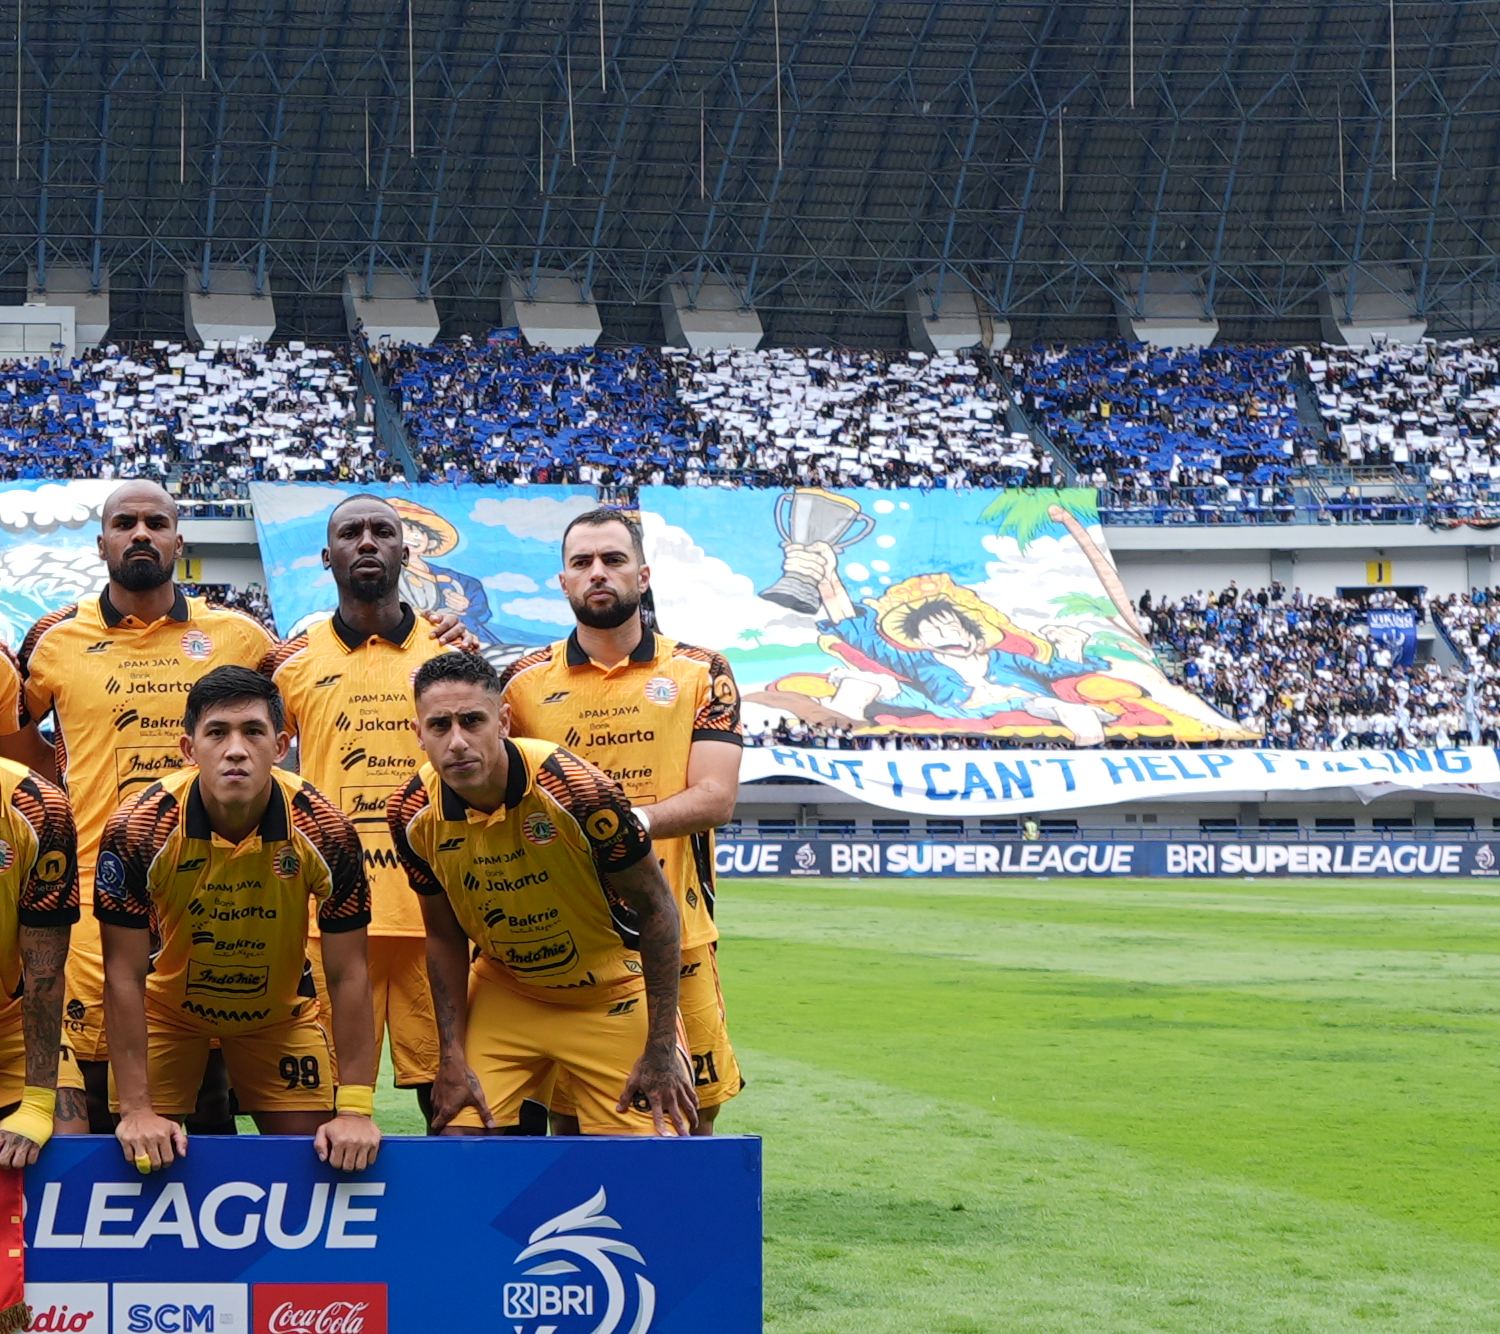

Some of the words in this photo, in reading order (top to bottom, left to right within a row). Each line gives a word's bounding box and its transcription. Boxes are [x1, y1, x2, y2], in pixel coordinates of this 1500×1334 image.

[185, 558, 193, 579] L
[1377, 562, 1383, 583] J
[153, 658, 180, 666] JAYA
[126, 681, 193, 694] Jakarta
[355, 695, 378, 703] PAM
[380, 694, 407, 702] JAYA
[585, 709, 609, 718] PAM
[612, 706, 640, 717] JAYA
[355, 718, 412, 732] Jakart
[586, 730, 655, 747] Jakarta
[367, 756, 416, 768] Bakrie
[603, 766, 652, 781] Bakrie
[890, 760, 904, 798] I
[923, 758, 1078, 801] CAN'T
[1100, 752, 1235, 785] HELP
[478, 854, 502, 865] PAM
[831, 845, 881, 873] BRI
[1167, 845, 1214, 873] BRI
[206, 881, 231, 892] PAM
[235, 880, 262, 891] JAYA
[485, 870, 549, 892] Jakarta
[209, 904, 277, 922] Jakarta
[508, 907, 559, 927] Bakrie
[215, 938, 266, 953] Bakrie
[64, 1021, 87, 1032] TCT
[279, 1055, 320, 1091] 98
[692, 1051, 717, 1086] 21
[540, 1285, 594, 1315] BRI
[22, 1305, 94, 1333] idio
[127, 1303, 215, 1333] SCM
[268, 1301, 371, 1334] Coca-Cola
